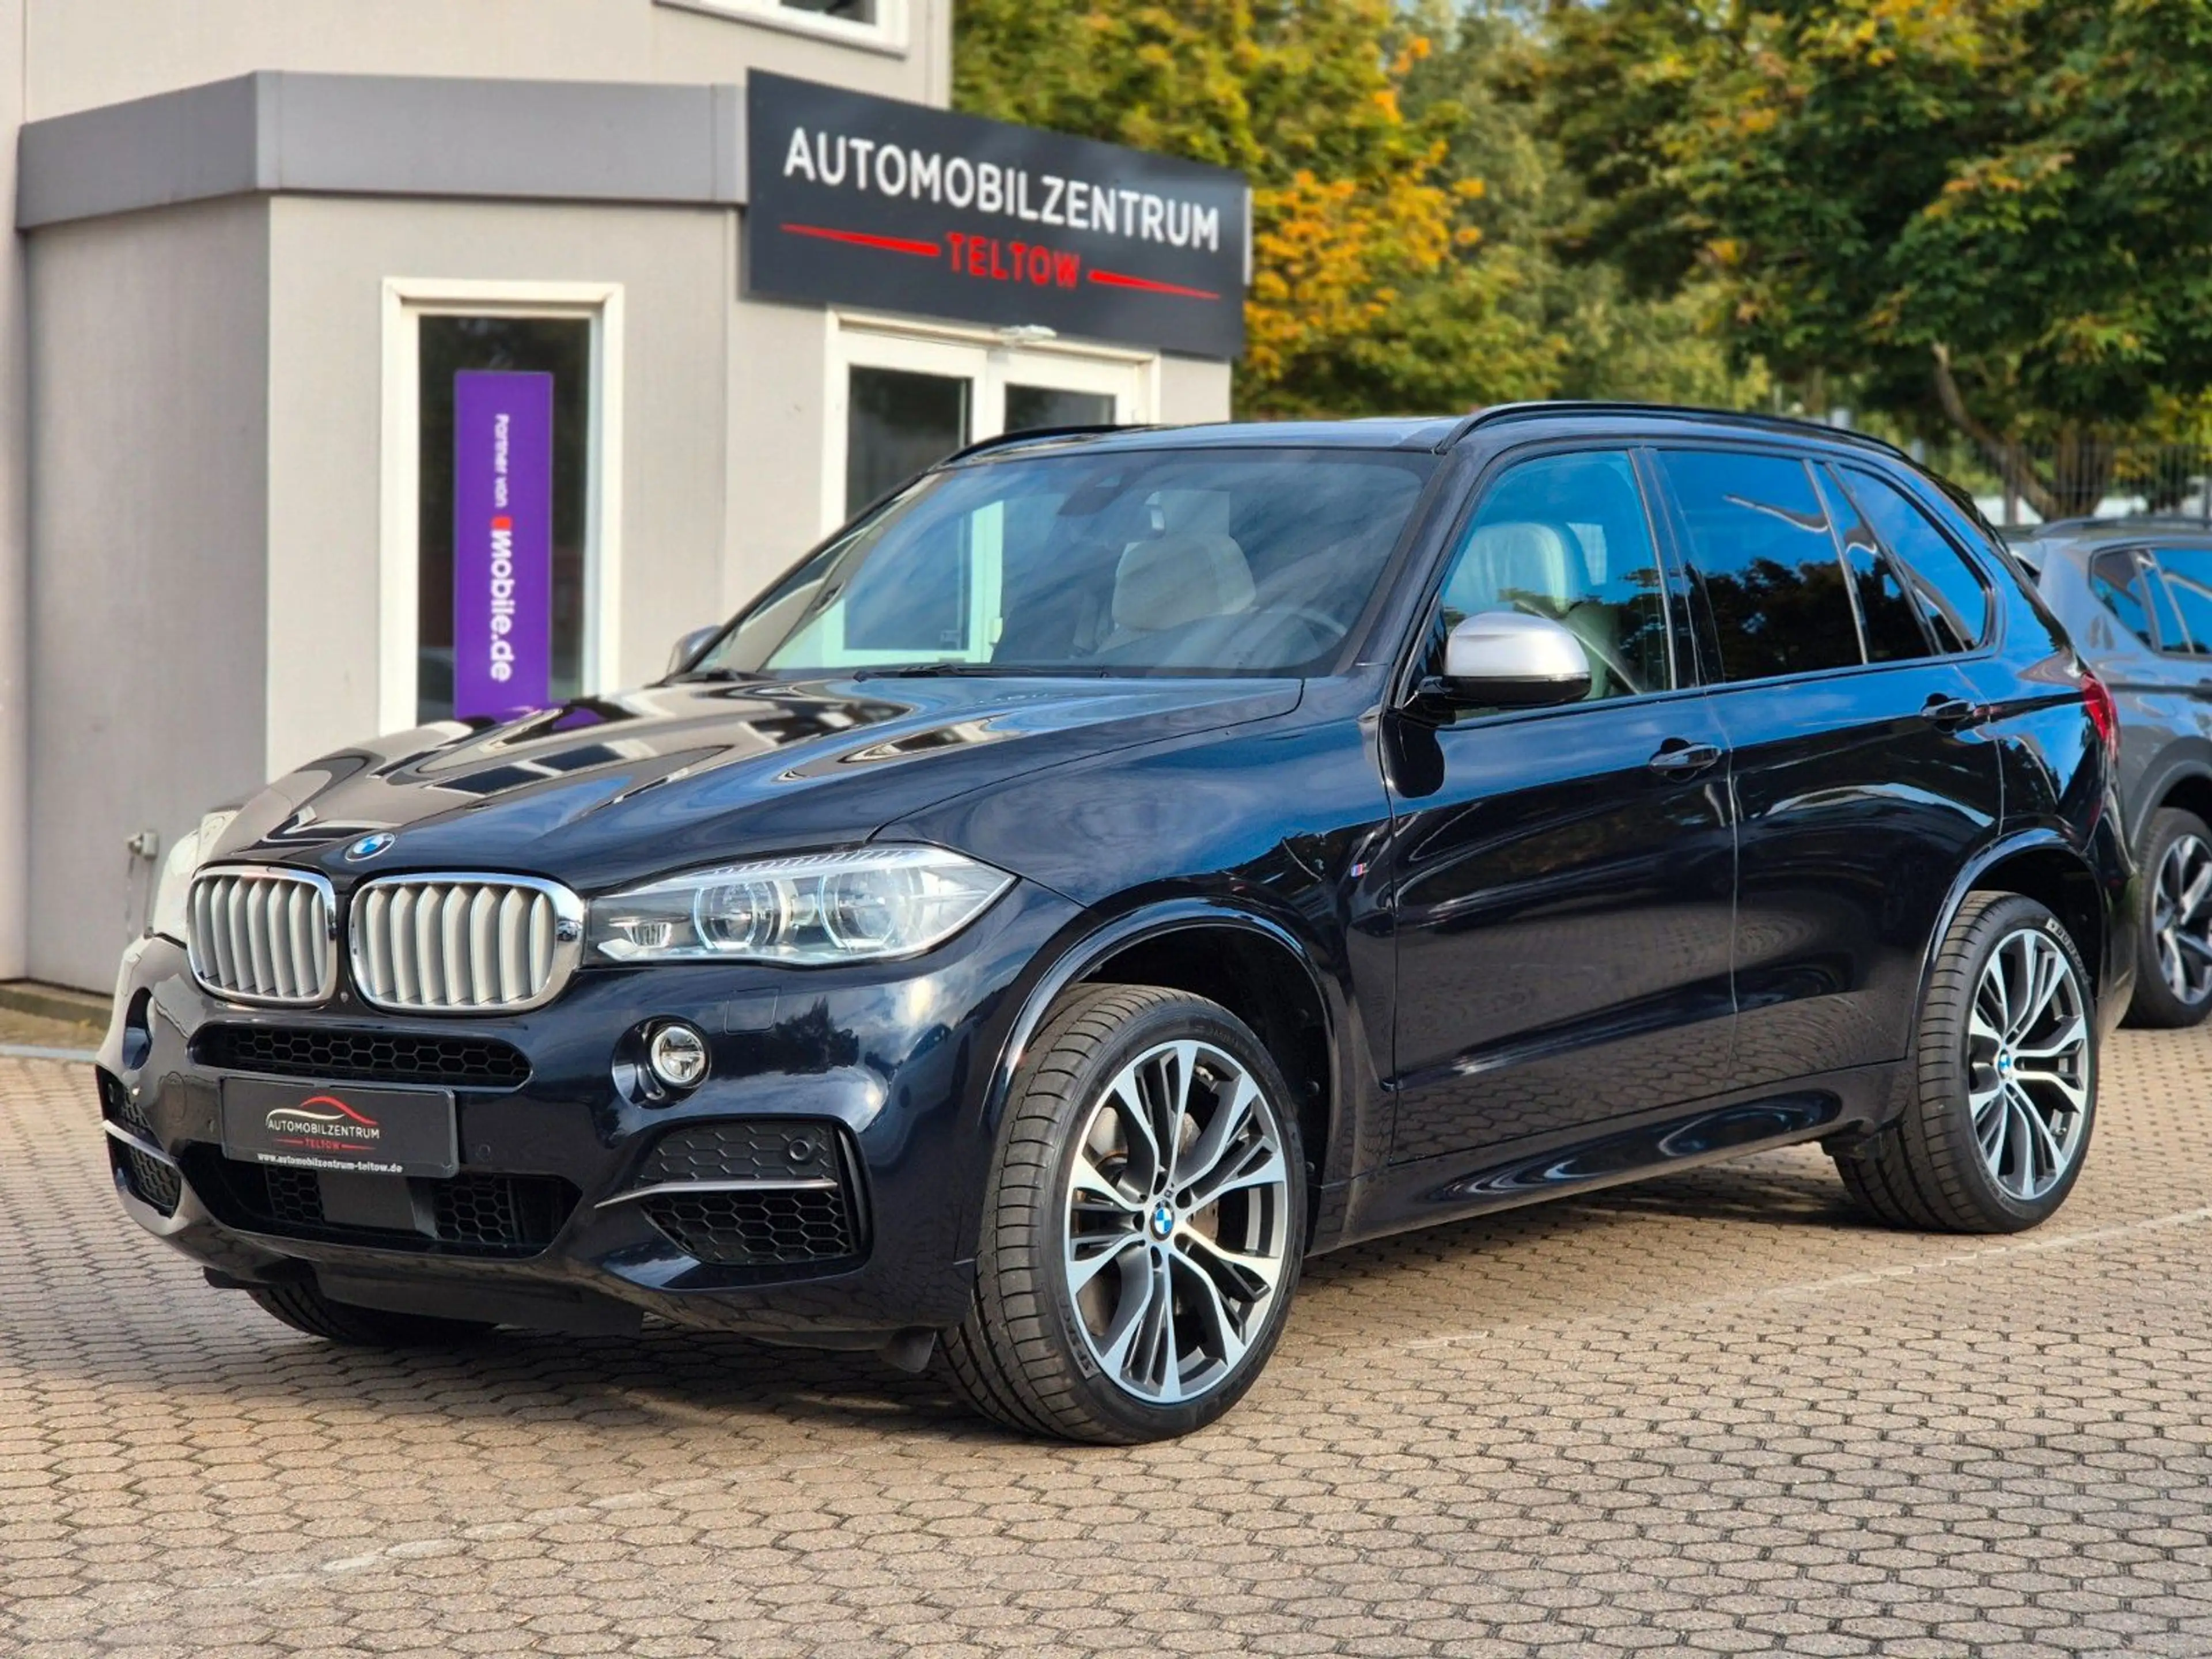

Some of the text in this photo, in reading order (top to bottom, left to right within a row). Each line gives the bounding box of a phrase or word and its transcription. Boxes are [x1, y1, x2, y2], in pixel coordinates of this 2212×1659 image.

[783, 126, 1219, 252] AUTOMOBILZENTRUM
[946, 232, 1081, 289] TELTOW
[491, 413, 516, 682] Partner von mobile.de
[267, 1119, 380, 1139] AUTOMOBILZENTRUM
[305, 1137, 341, 1150] TELTOW
[257, 1153, 403, 1173] www.automobilzentrum-teltow.de
